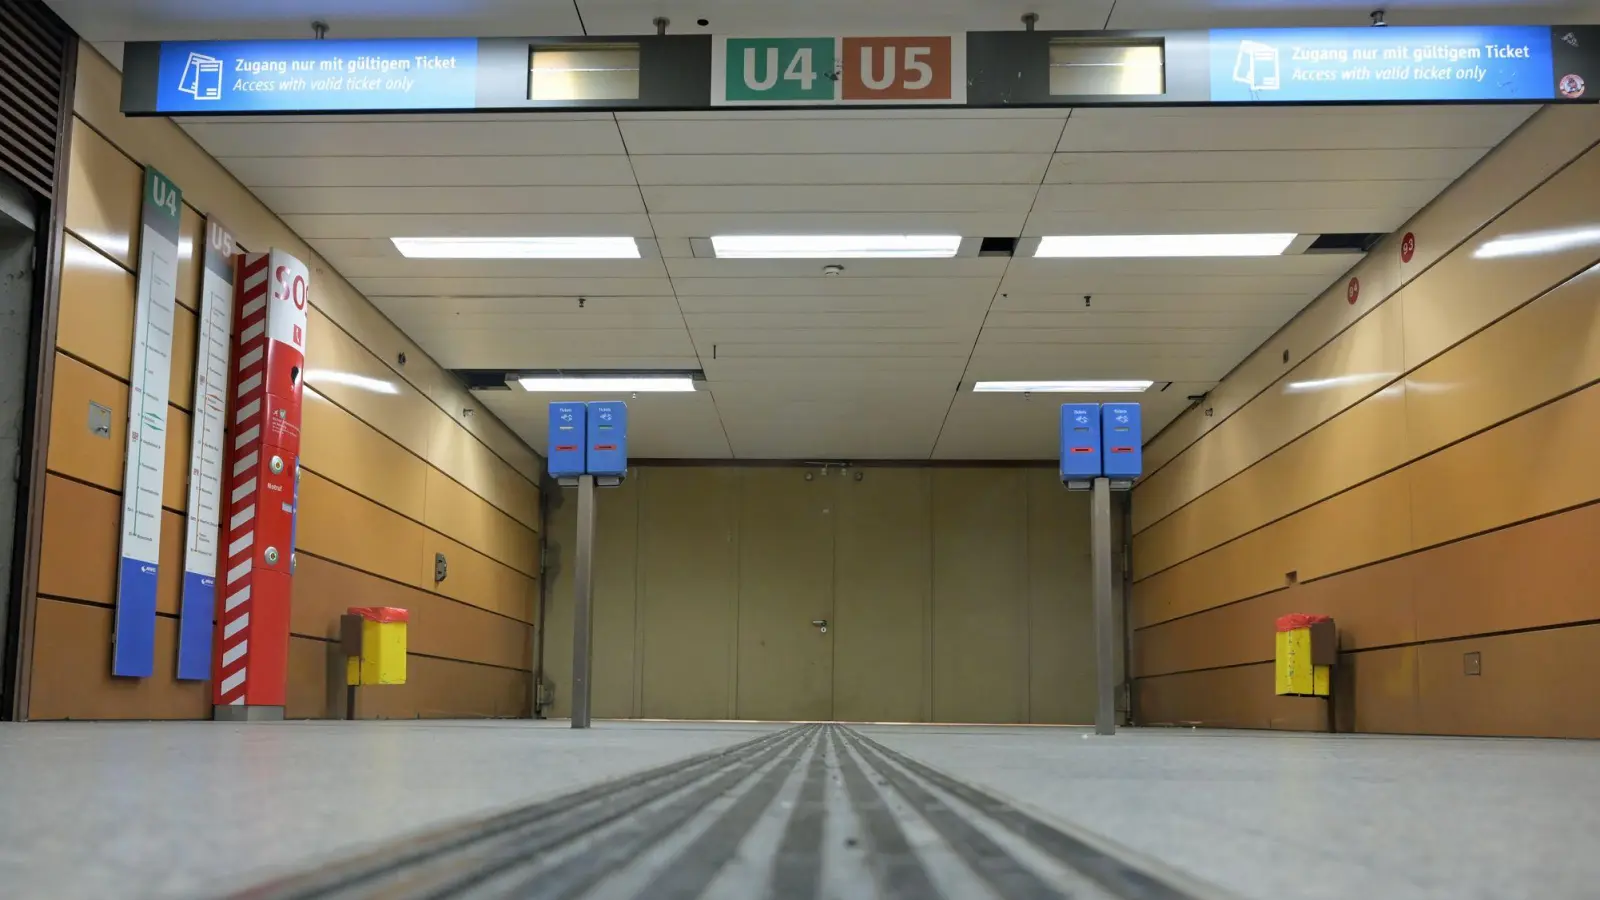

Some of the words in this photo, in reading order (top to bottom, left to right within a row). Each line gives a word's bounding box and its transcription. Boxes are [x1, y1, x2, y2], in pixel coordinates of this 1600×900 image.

[1291, 45, 1348, 63] Zugang
[1352, 47, 1378, 60] nur
[1383, 45, 1409, 60] mit
[1413, 45, 1481, 62] gültigem
[1485, 44, 1531, 58] Ticket
[235, 58, 287, 75] Zugang
[292, 60, 315, 71] nur
[319, 56, 343, 71] mit
[347, 55, 411, 73] gültigem
[415, 55, 456, 69] Ticket
[743, 47, 817, 91] U4
[860, 46, 933, 90] U5
[1291, 66, 1336, 81] Access
[1341, 65, 1371, 80] with
[1375, 66, 1410, 80] valid
[1413, 65, 1452, 80] ticket
[1455, 65, 1487, 82] only
[232, 78, 275, 91] Access
[279, 77, 307, 91] with
[310, 76, 343, 91] valid
[347, 76, 381, 91] ticket
[385, 75, 415, 93] only
[153, 175, 177, 217] U4
[212, 222, 232, 258] U5
[1402, 239, 1413, 254] 93
